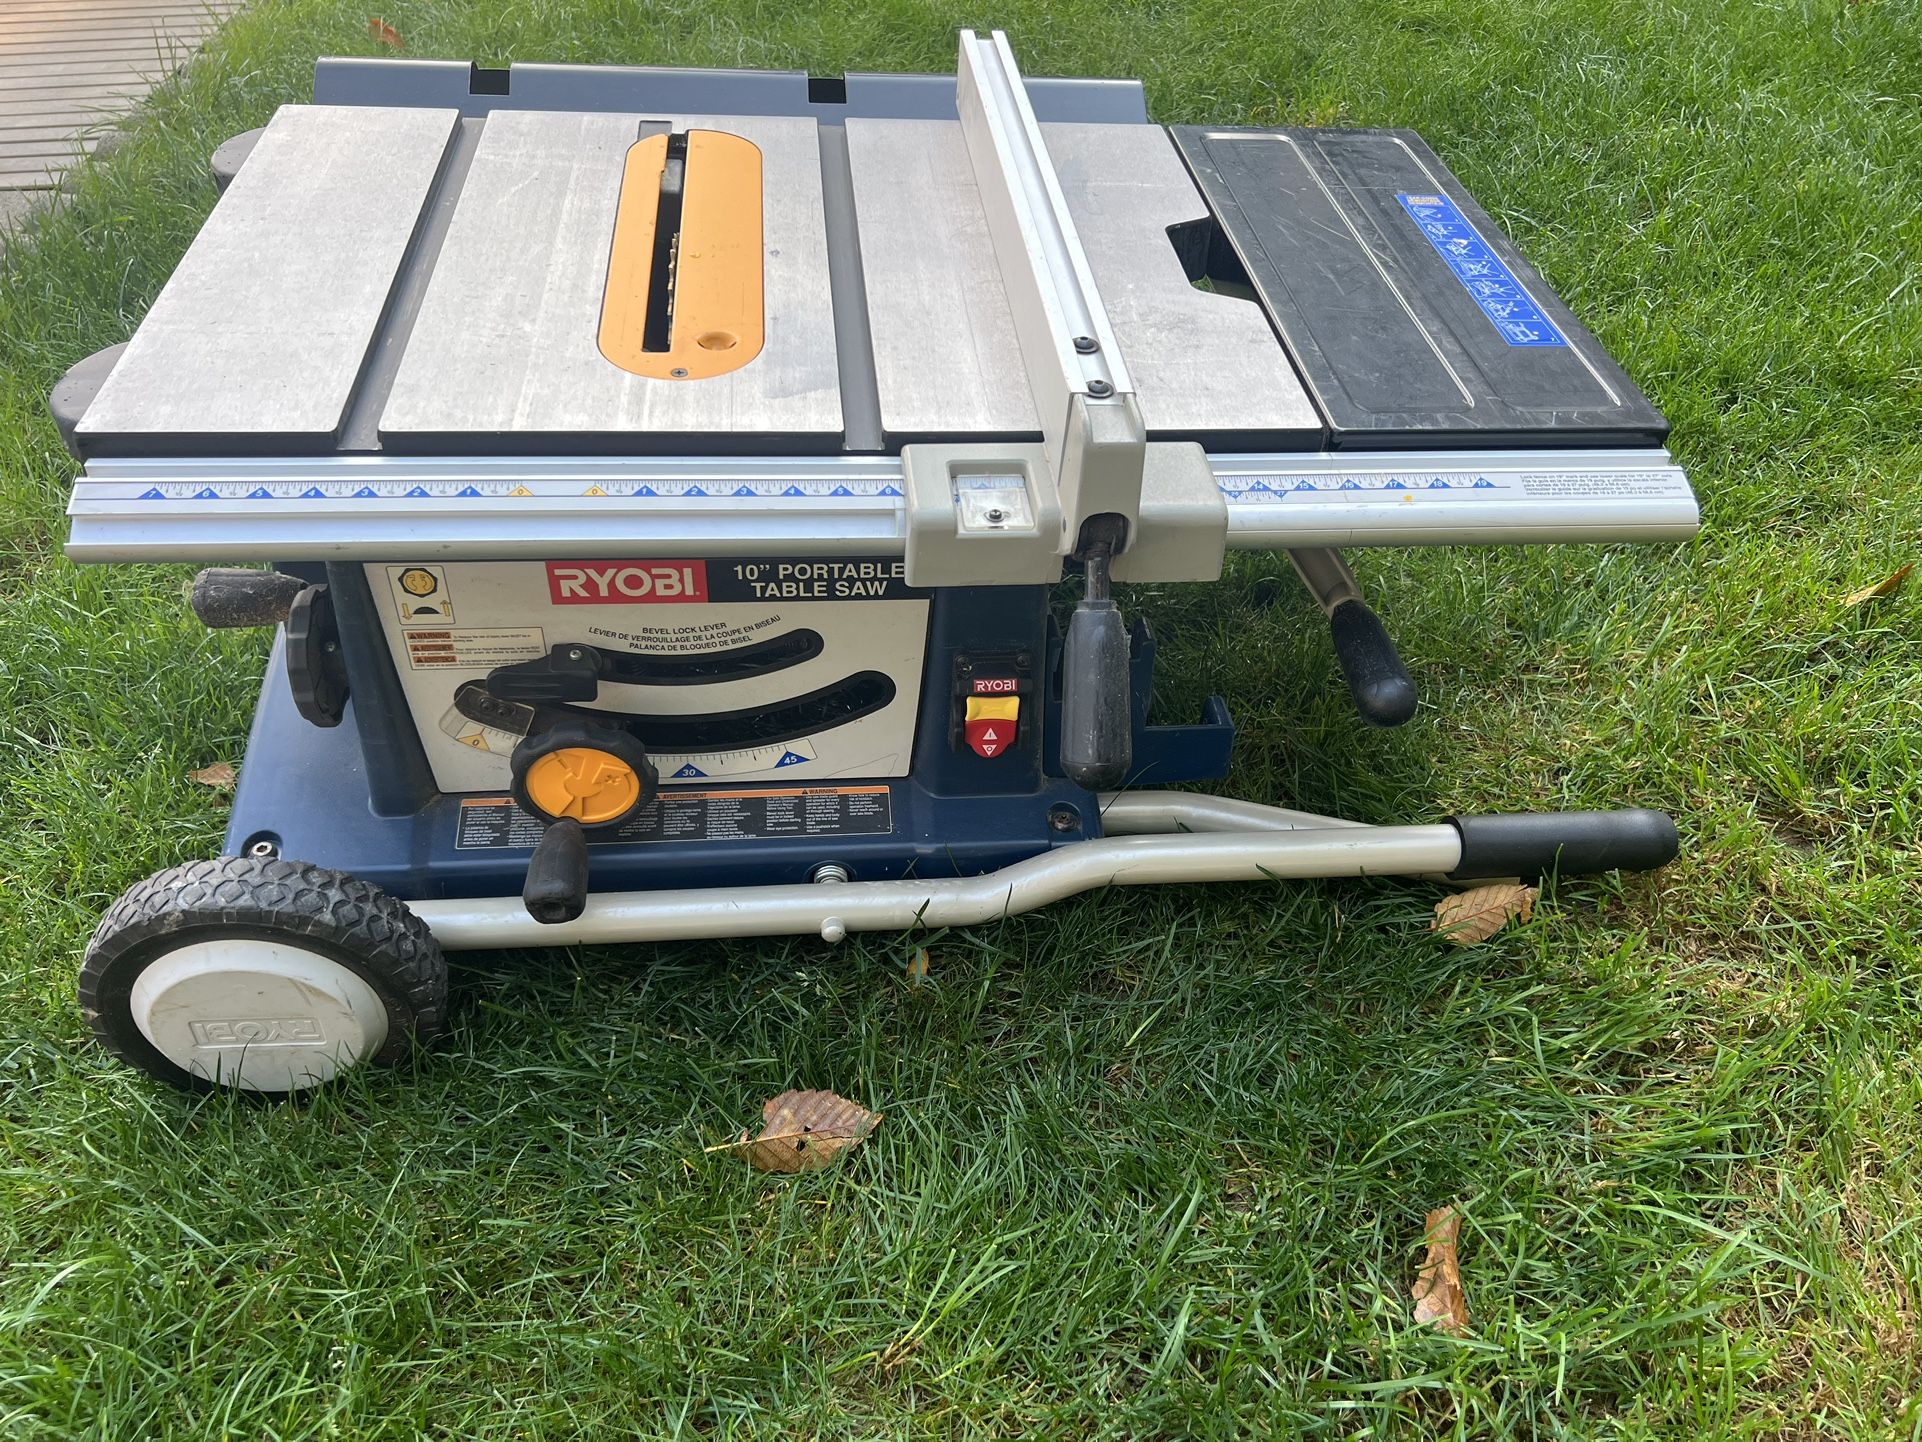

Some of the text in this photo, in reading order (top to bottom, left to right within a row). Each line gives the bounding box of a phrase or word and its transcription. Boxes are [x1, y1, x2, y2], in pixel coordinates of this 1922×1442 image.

[778, 563, 904, 579] PORTABLE
[554, 568, 695, 597] RYOBI
[751, 581, 887, 597] TABLE SAW
[589, 626, 617, 638] LEVIER
[631, 635, 691, 643] VERROUILLAGE
[716, 628, 742, 639] COUPE
[754, 614, 781, 630] BISEAU
[698, 623, 727, 632] LEVER
[629, 643, 666, 651] PALANCA
[680, 641, 717, 651] BLOQUEO
[731, 635, 752, 644] BISEL
[976, 680, 1016, 691] RYOBI
[784, 756, 797, 764] 45
